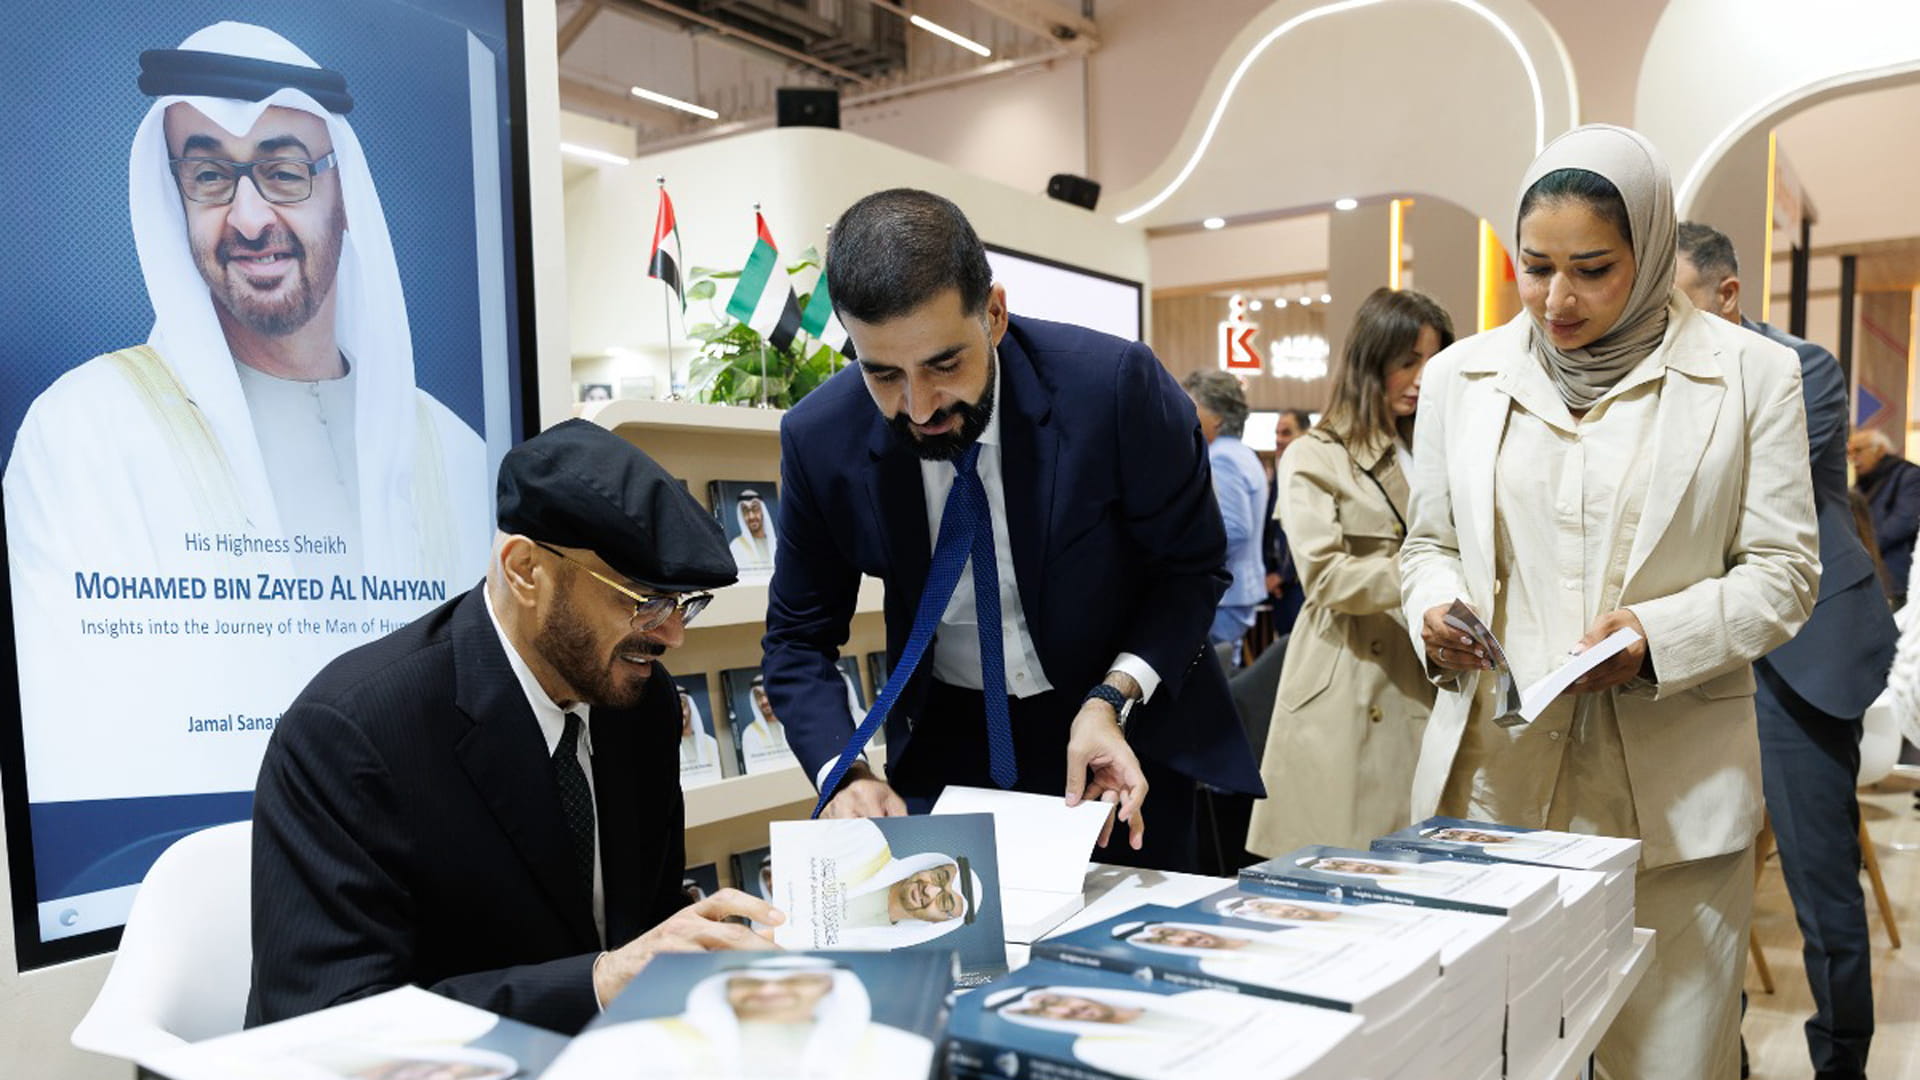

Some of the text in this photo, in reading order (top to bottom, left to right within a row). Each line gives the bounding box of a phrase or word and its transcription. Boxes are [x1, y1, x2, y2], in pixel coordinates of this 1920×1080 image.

[184, 533, 347, 557] His Highness Sheikh
[81, 618, 144, 639] Insights
[148, 618, 180, 635] into
[184, 619, 209, 635] the
[213, 619, 273, 637] Journey
[277, 618, 293, 635] of
[297, 618, 321, 635] the
[325, 620, 357, 635] Man
[361, 619, 376, 635] of
[188, 714, 233, 732] Jamal
